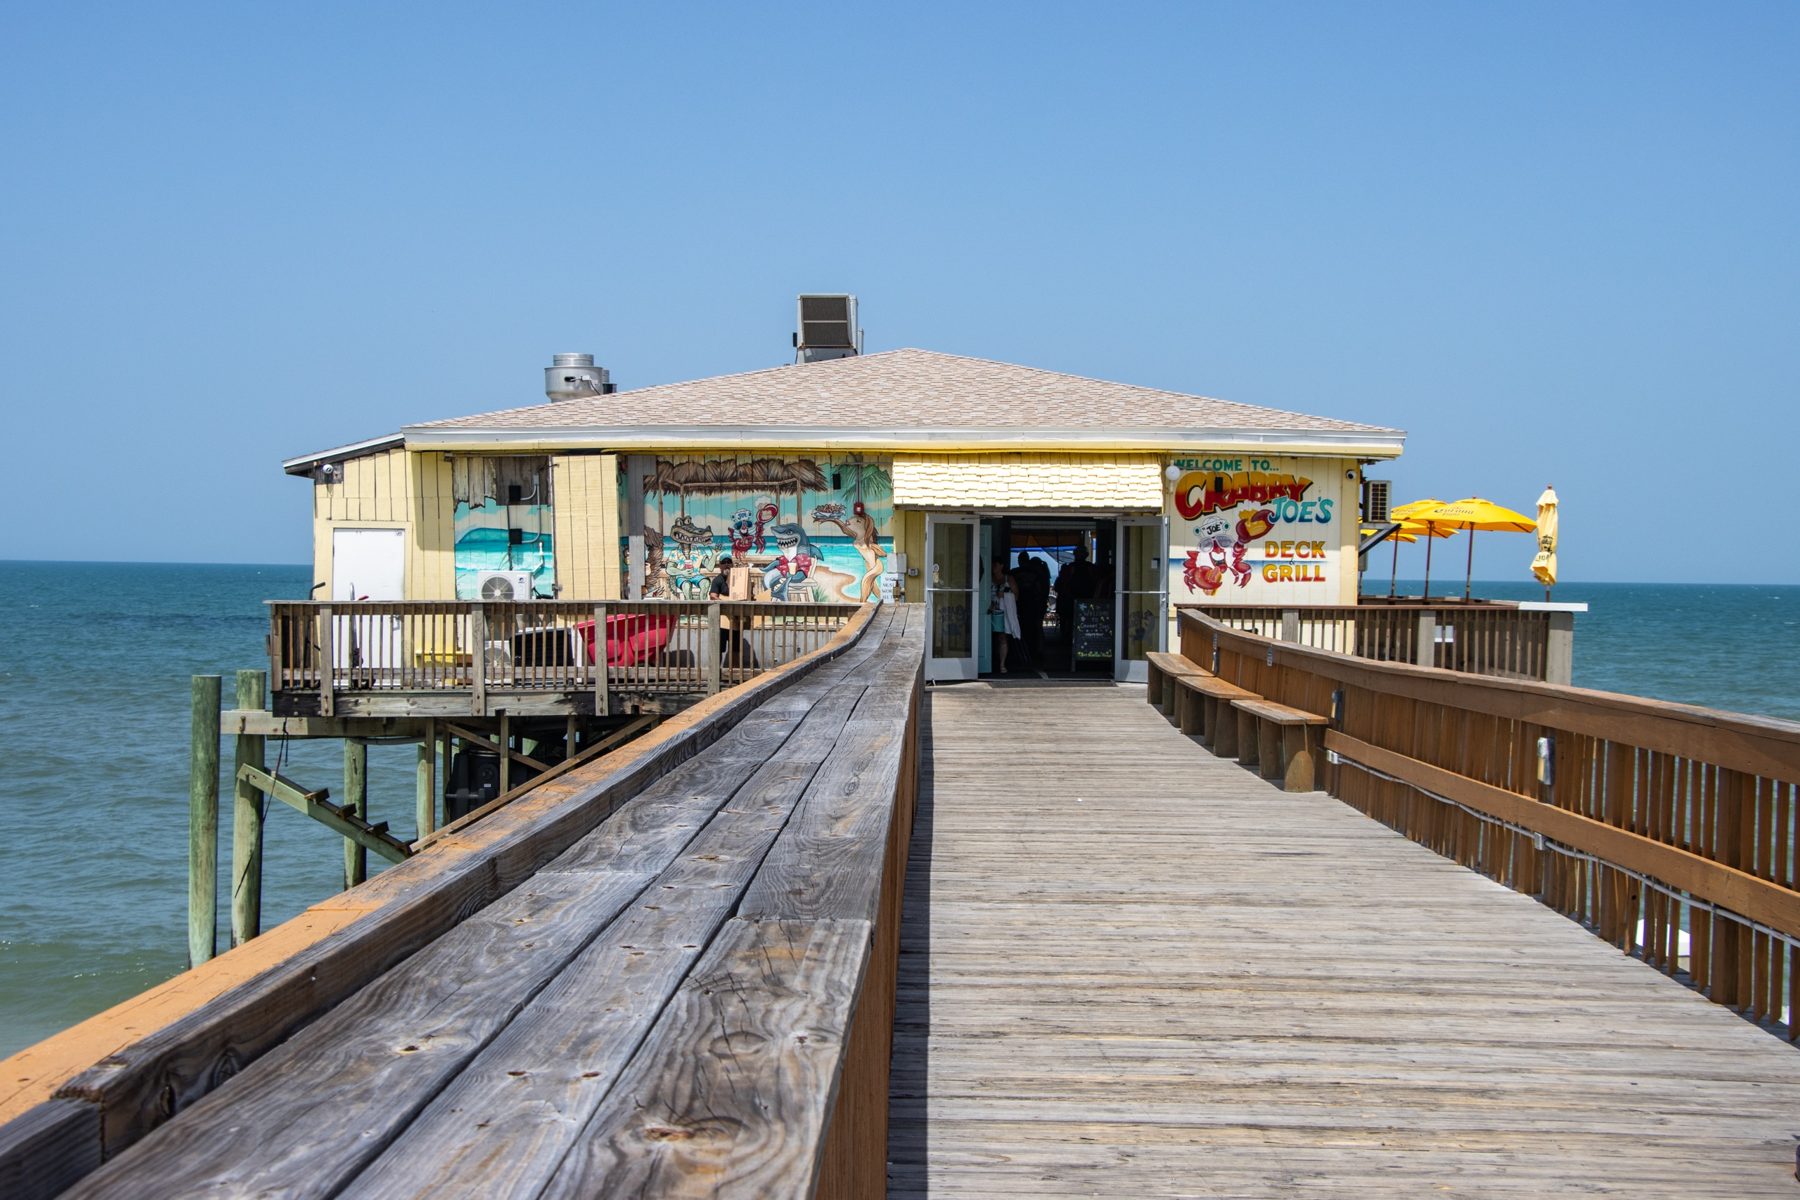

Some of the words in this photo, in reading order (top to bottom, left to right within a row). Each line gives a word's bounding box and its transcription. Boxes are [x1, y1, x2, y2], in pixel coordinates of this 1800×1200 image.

[1174, 459, 1242, 471] WELCOME
[1175, 471, 1313, 521] CRABBY
[1269, 496, 1334, 523] JOE'S
[1265, 541, 1326, 558] DECK
[1263, 563, 1326, 583] GRILL
